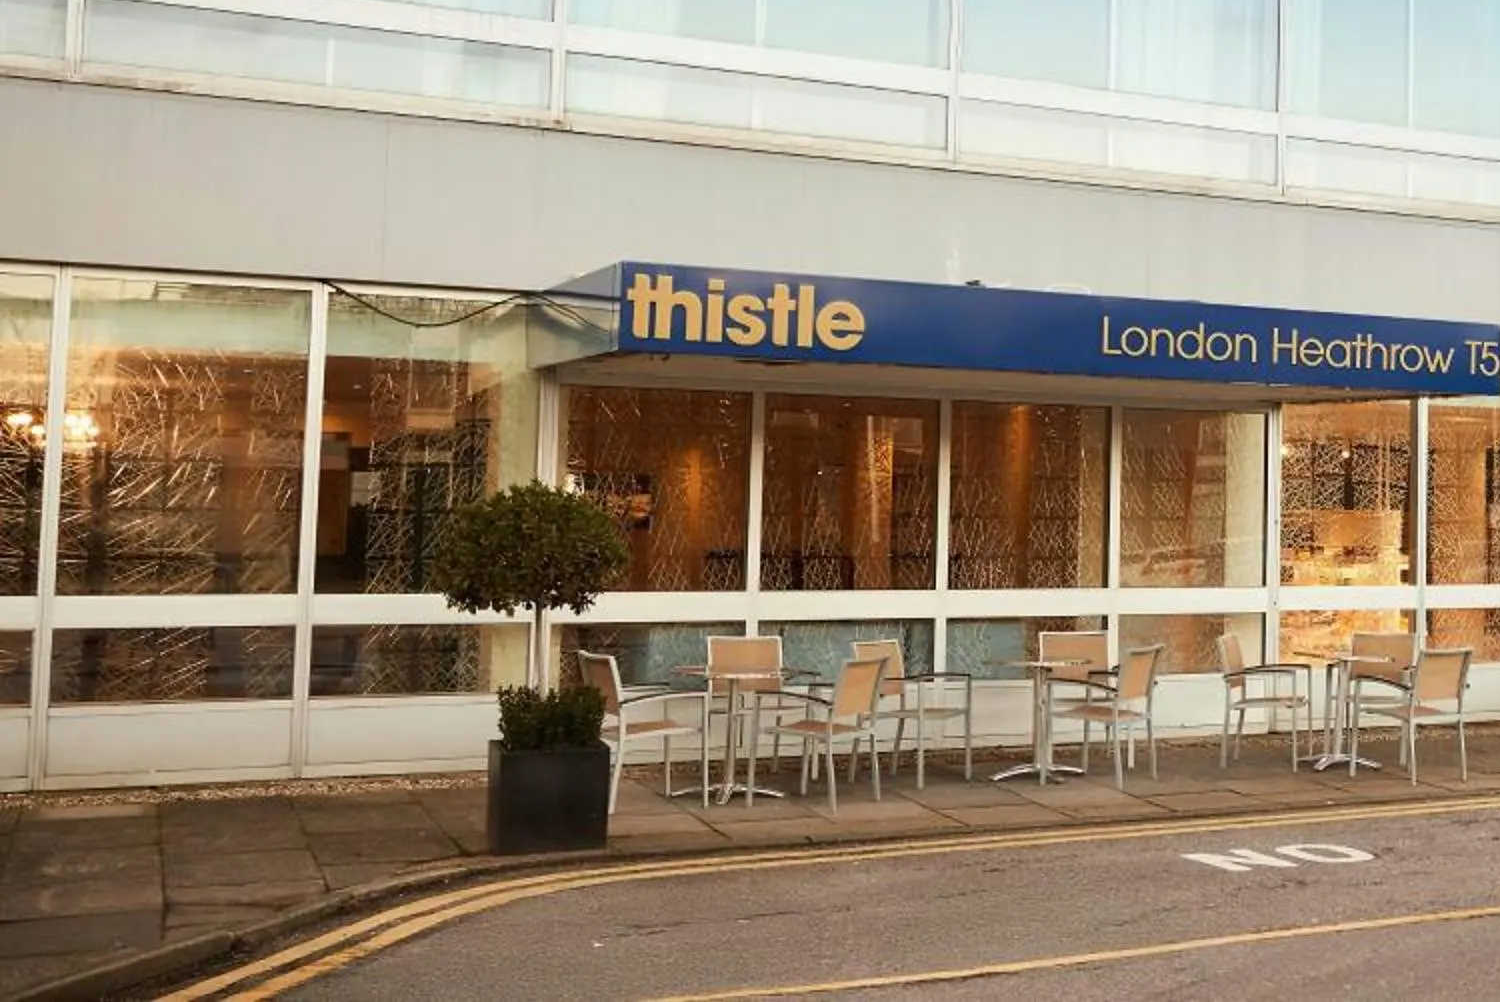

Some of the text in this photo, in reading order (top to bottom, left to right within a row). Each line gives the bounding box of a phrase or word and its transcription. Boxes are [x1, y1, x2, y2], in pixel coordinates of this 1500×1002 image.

[626, 273, 866, 351] thistle
[1101, 316, 1500, 376] London Heathrow T5
[1180, 843, 1375, 873] NO
